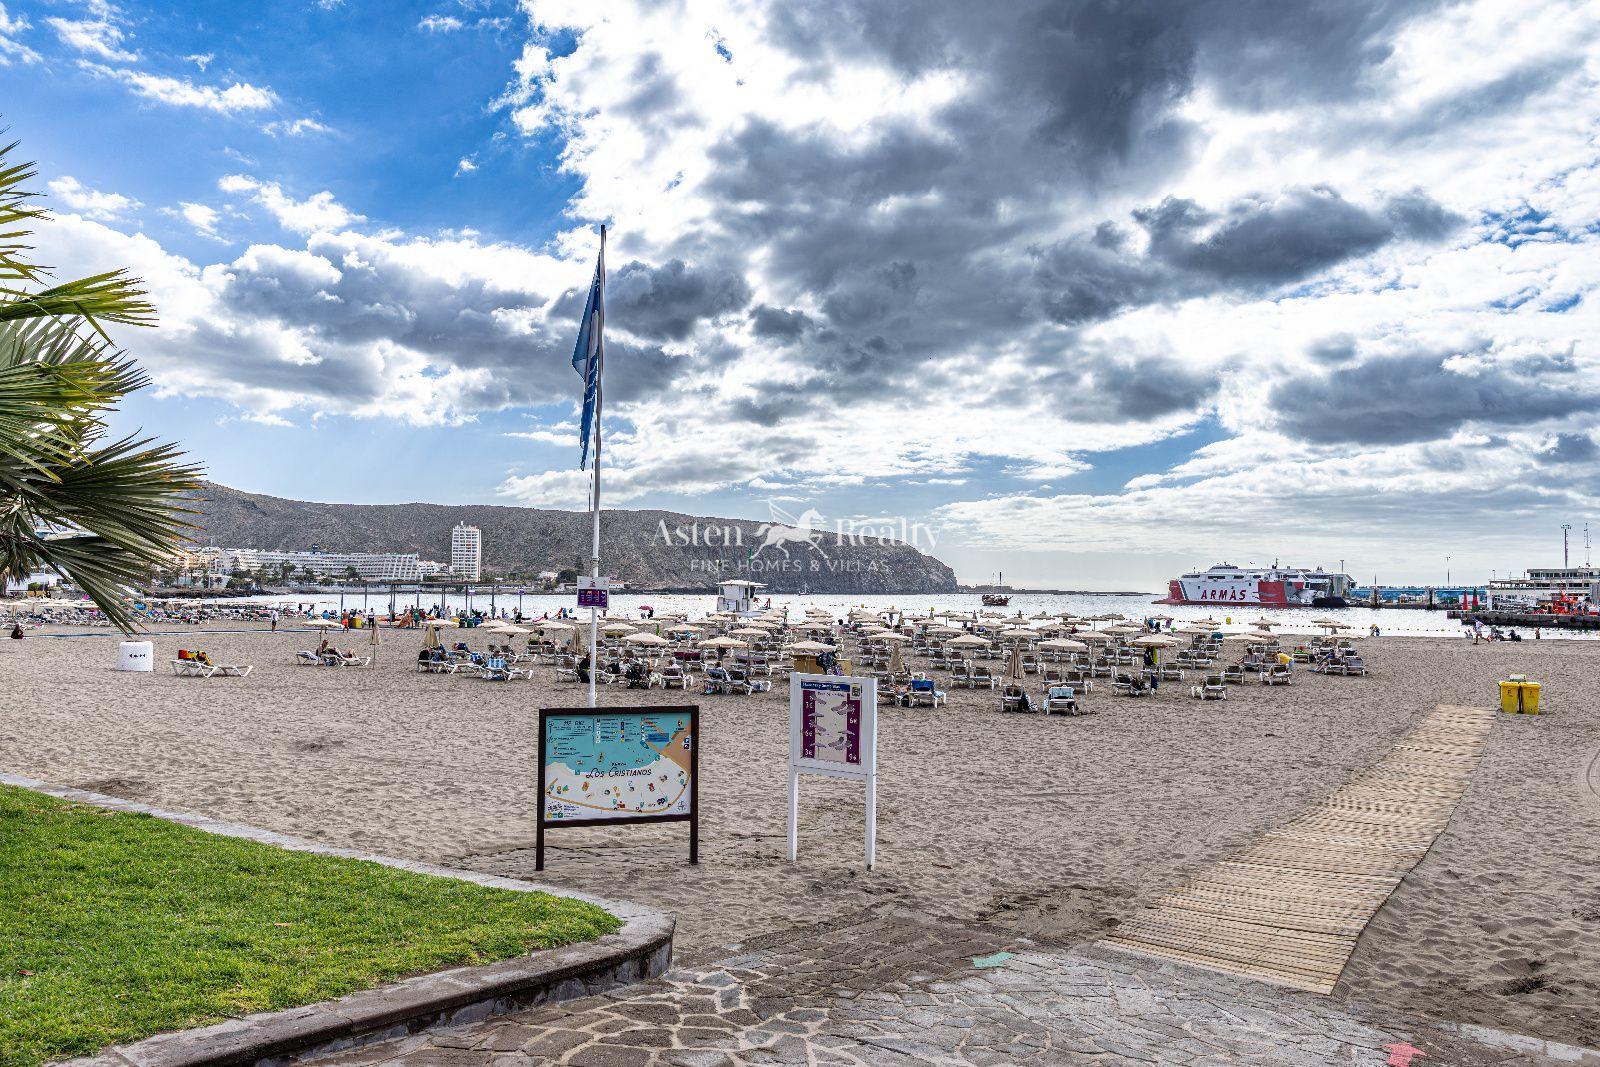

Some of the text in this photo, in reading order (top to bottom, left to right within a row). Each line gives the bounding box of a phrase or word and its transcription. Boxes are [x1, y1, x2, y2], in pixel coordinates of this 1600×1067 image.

[1201, 589, 1247, 601] ARMAS
[585, 766, 652, 779] LOS CRISTIANOS
